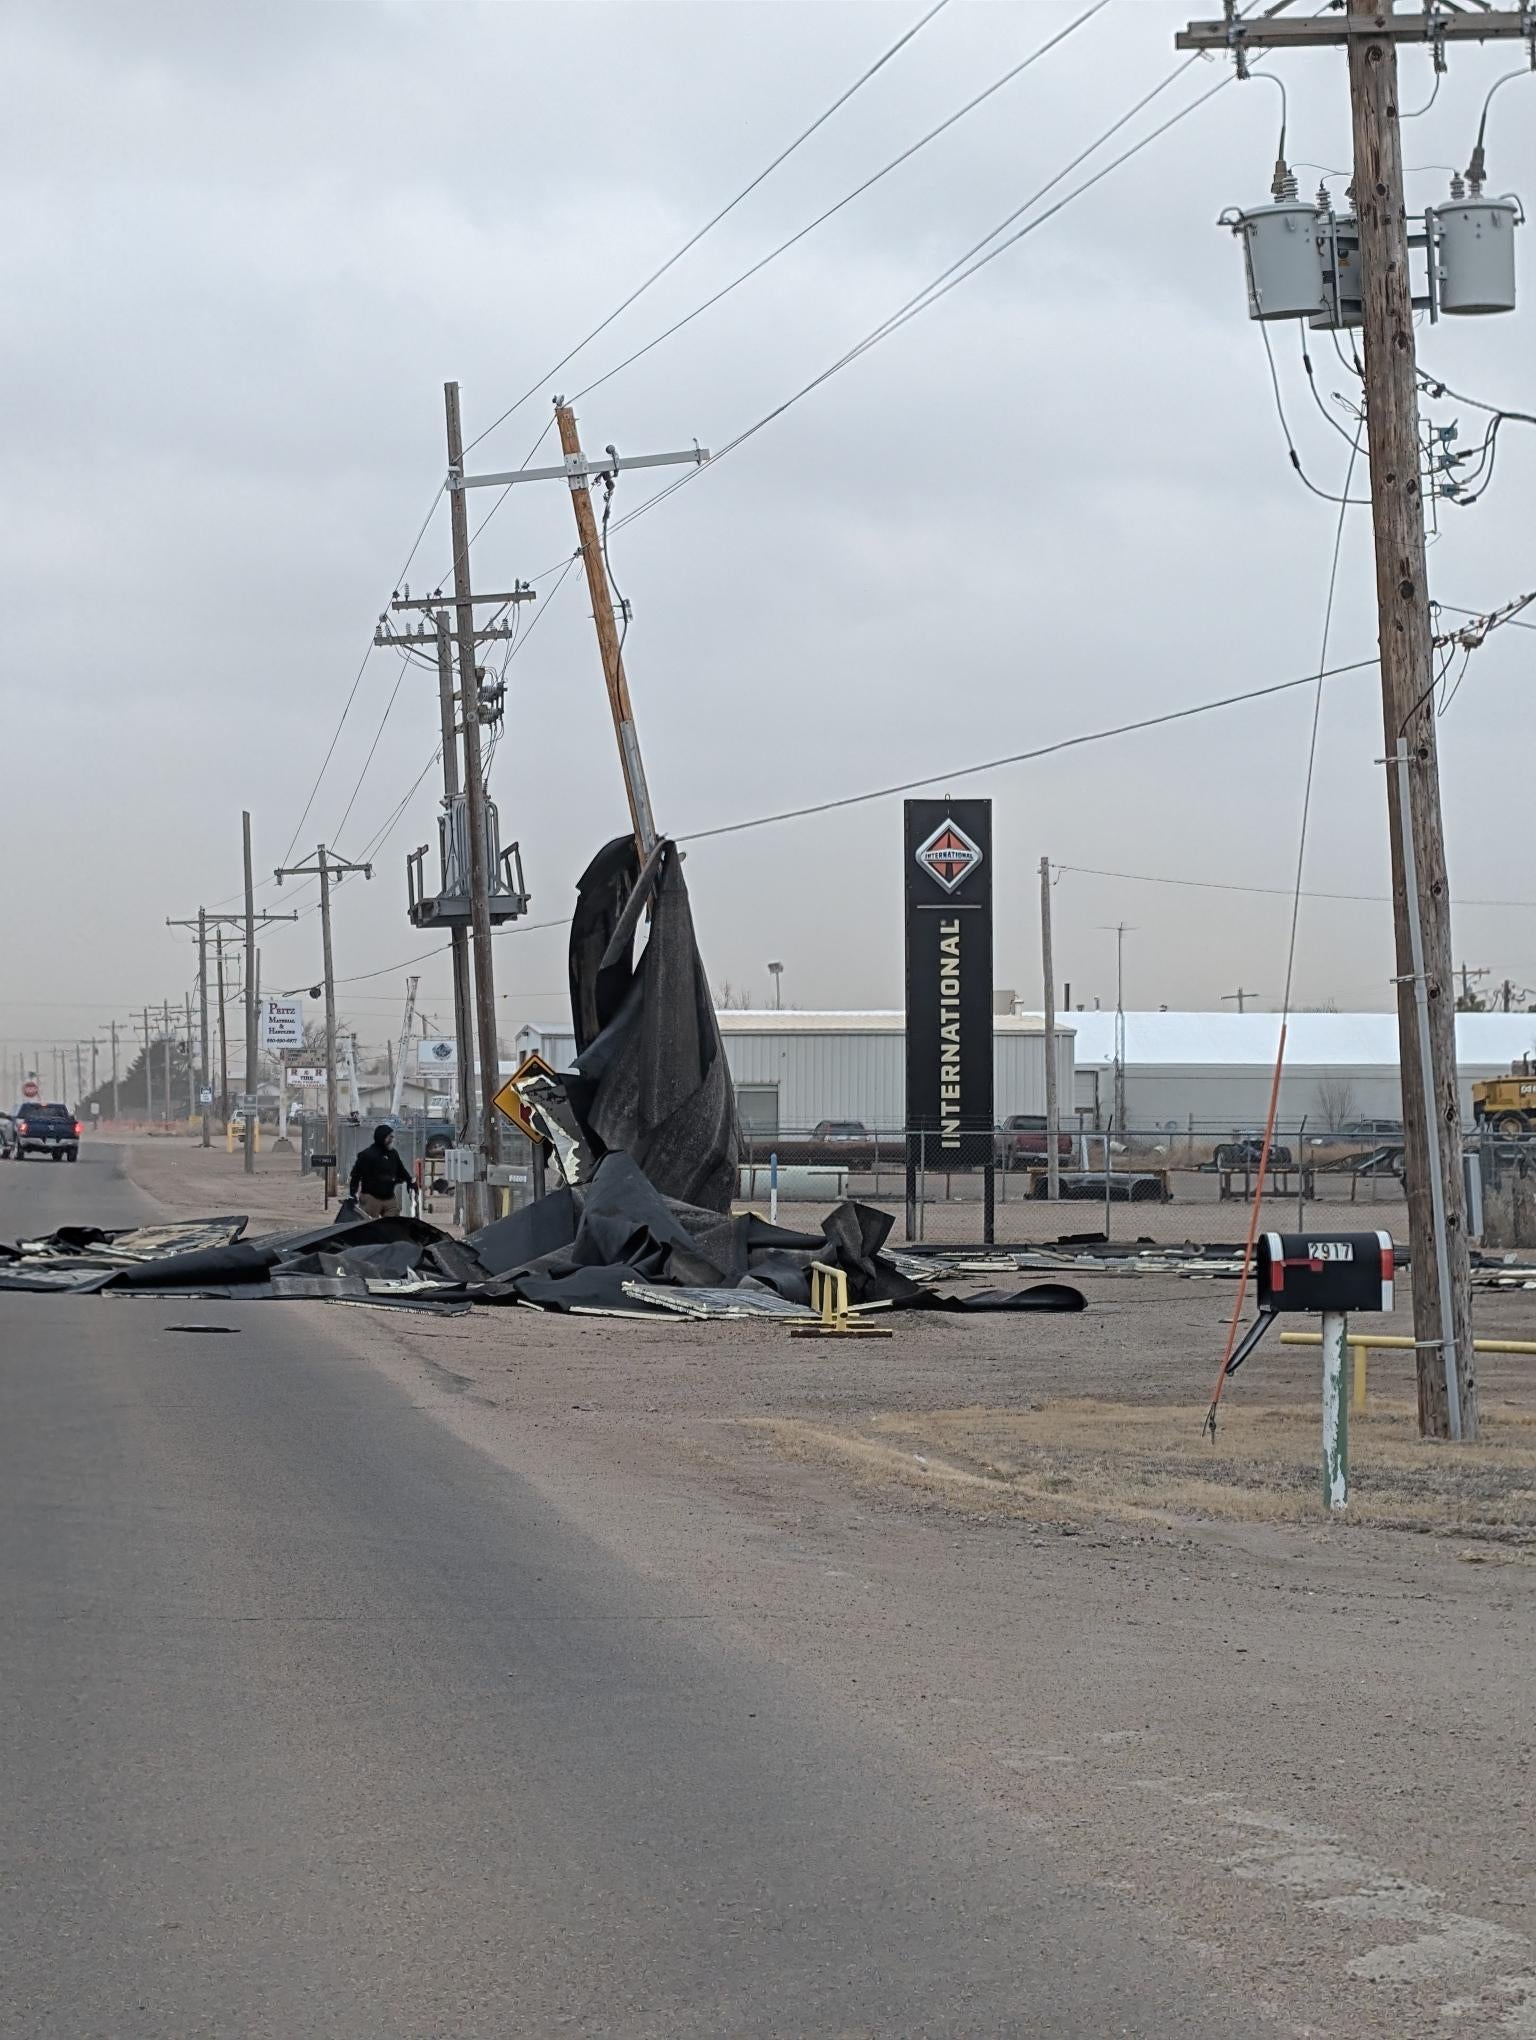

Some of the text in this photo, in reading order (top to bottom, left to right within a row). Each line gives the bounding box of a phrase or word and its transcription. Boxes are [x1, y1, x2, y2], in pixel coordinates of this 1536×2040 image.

[925, 851, 973, 859] INTERNATIONAL
[940, 919, 961, 1148] INTERNATIONAL
[1310, 1243, 1350, 1259] 2917
